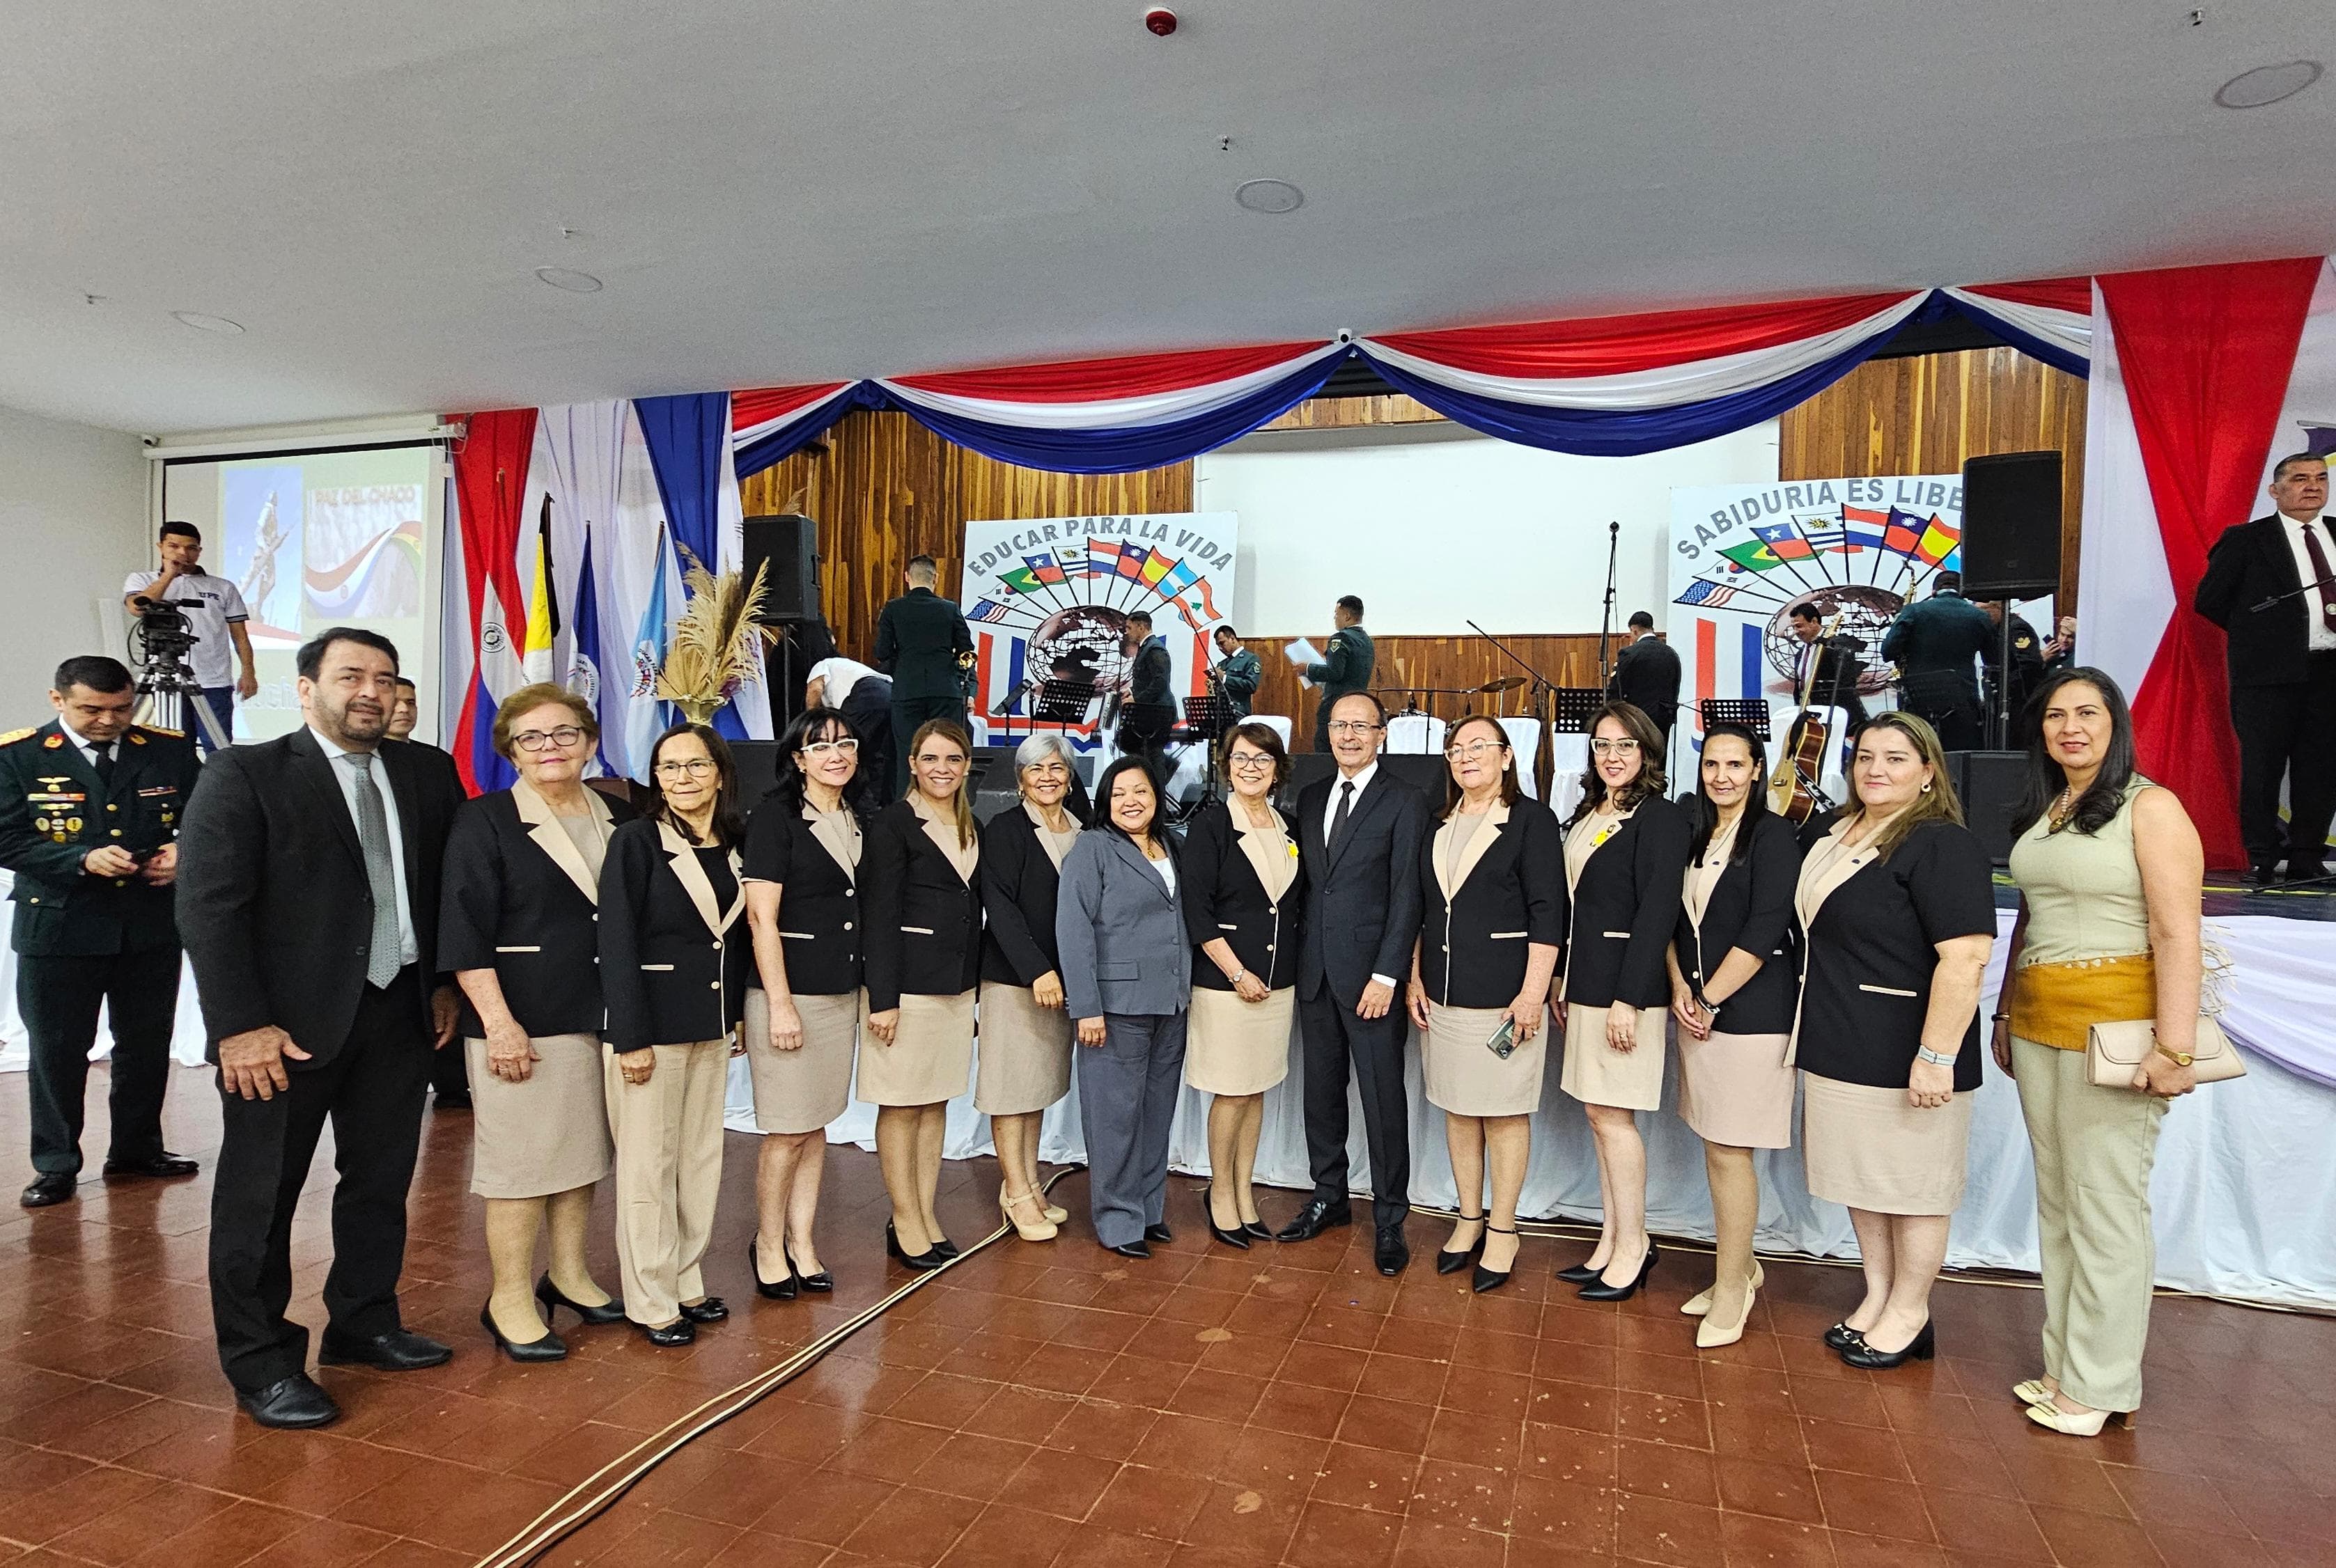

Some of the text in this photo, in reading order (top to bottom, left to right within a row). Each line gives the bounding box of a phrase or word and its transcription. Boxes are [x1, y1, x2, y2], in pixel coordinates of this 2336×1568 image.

[967, 517, 1233, 577] EDUCAR PARA LA VIDA
[1677, 478, 1963, 559] SABIDURIA ES LIBE
